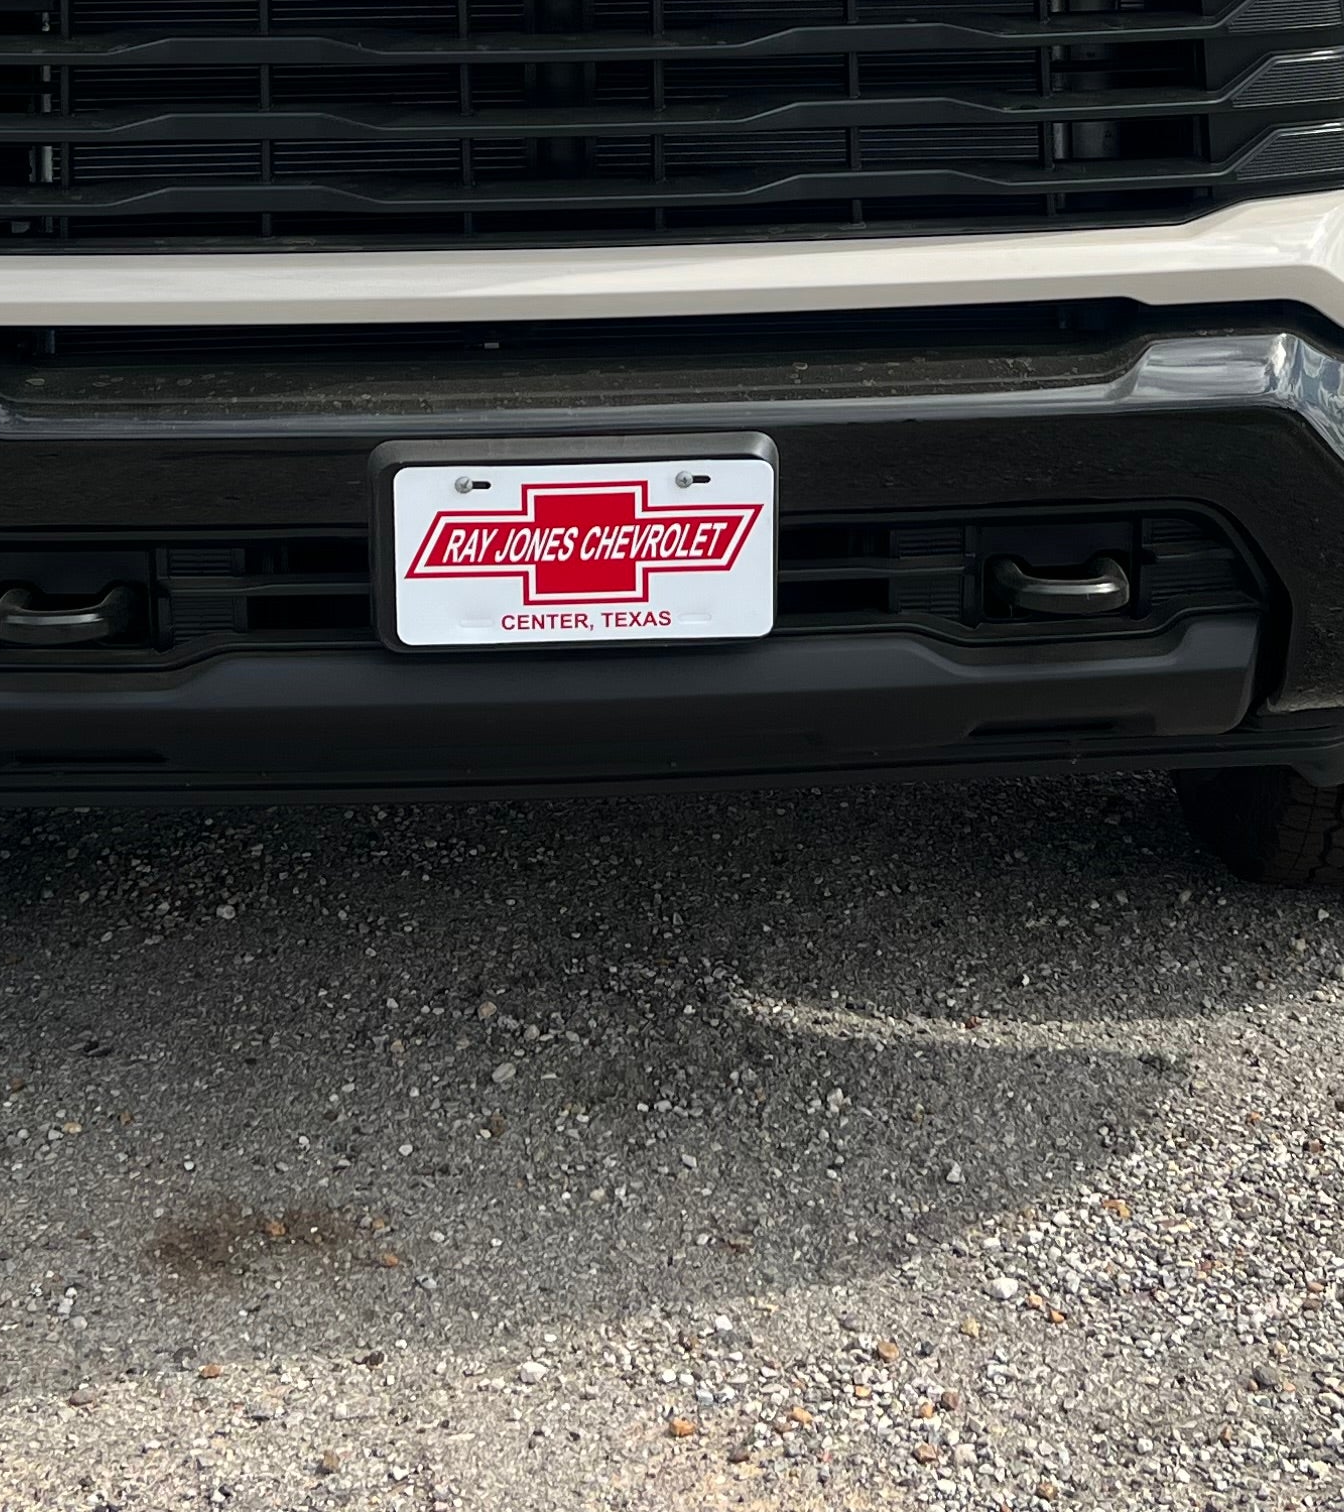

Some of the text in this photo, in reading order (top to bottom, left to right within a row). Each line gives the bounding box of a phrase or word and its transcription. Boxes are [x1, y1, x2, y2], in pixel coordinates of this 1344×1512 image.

[442, 523, 727, 563] RAY JONES CHEVROLET
[501, 610, 672, 631] CENTER, TEXAS
